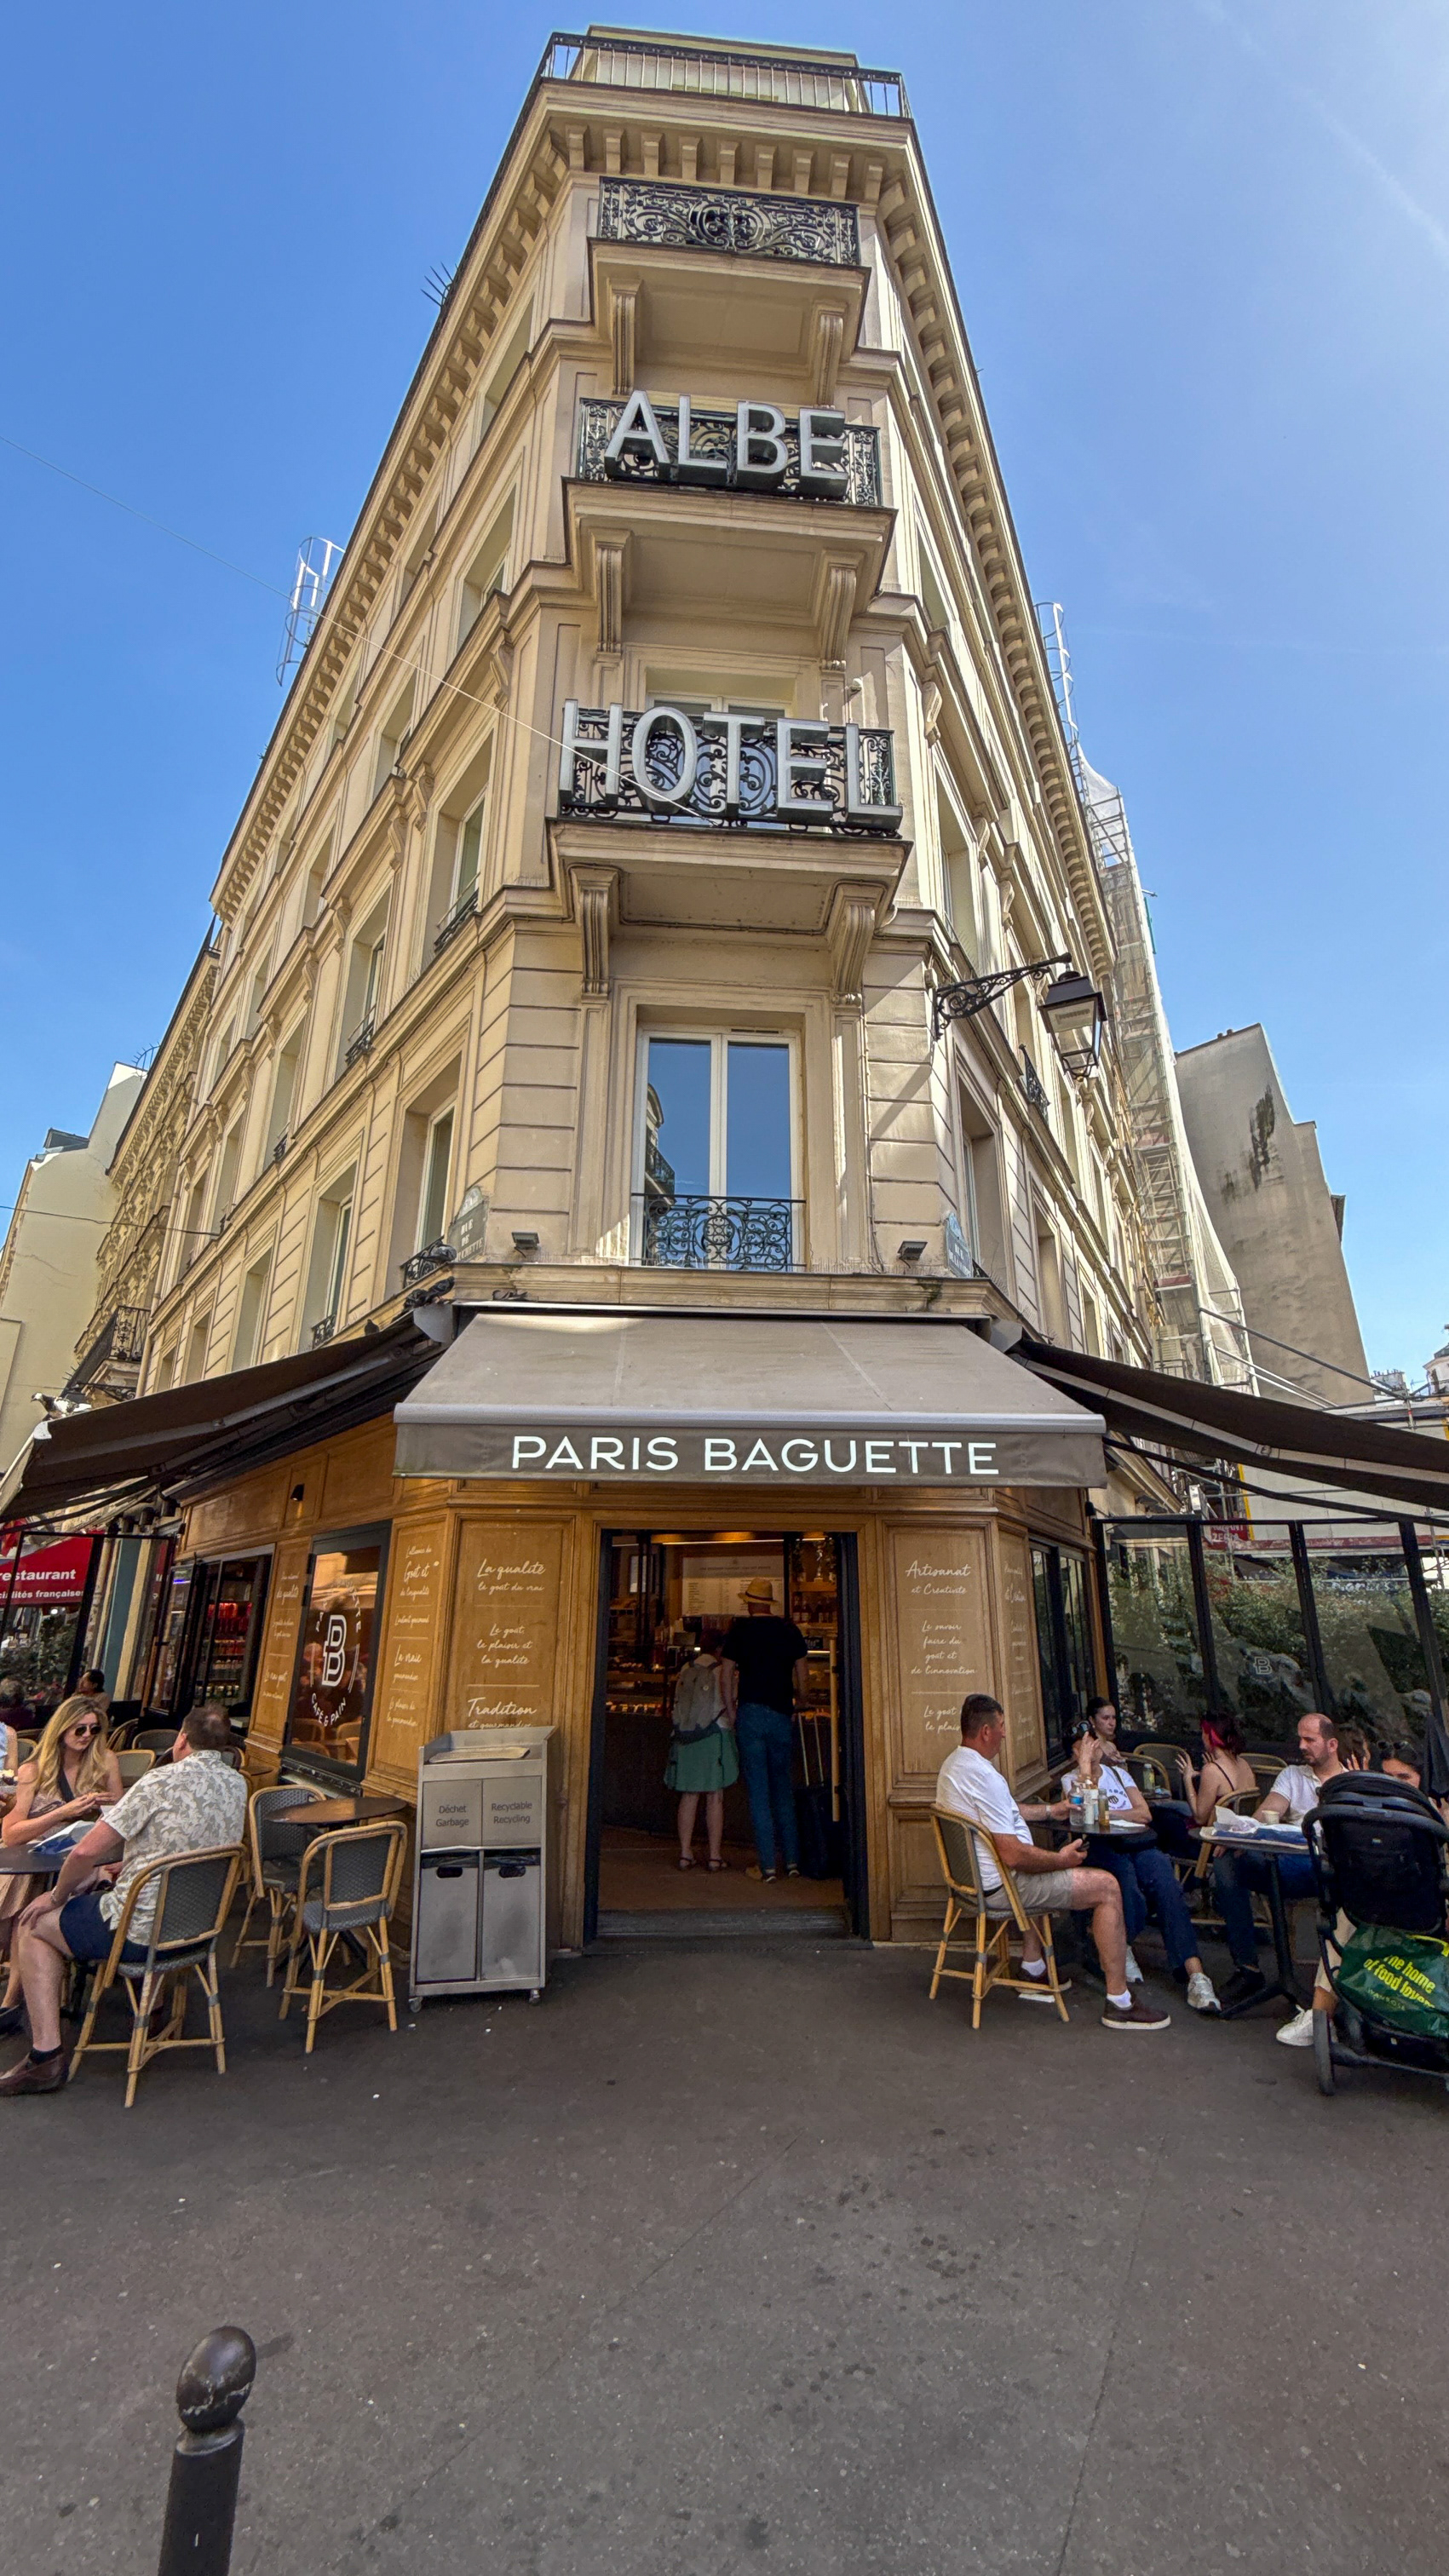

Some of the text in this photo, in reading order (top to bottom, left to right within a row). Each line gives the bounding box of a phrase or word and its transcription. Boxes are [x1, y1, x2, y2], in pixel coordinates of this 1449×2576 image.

[604, 390, 848, 499] ALBE
[559, 699, 903, 828] HOTEL
[511, 1435, 999, 1475] PARIS BAGUETTE
[477, 1558, 496, 1578] La
[906, 1560, 972, 1579] Artisanat
[330, 1696, 347, 1726] PAIN
[468, 1697, 538, 1717] Tradition
[937, 1721, 961, 1734] plais
[439, 1804, 467, 1814] Déchet
[491, 1801, 532, 1813] Recyclable
[435, 1817, 469, 1828] Garbage
[493, 1814, 531, 1825] Recycling
[1364, 1958, 1380, 1971] of
[1373, 1964, 1403, 1991] food
[1401, 1961, 1436, 1994] home
